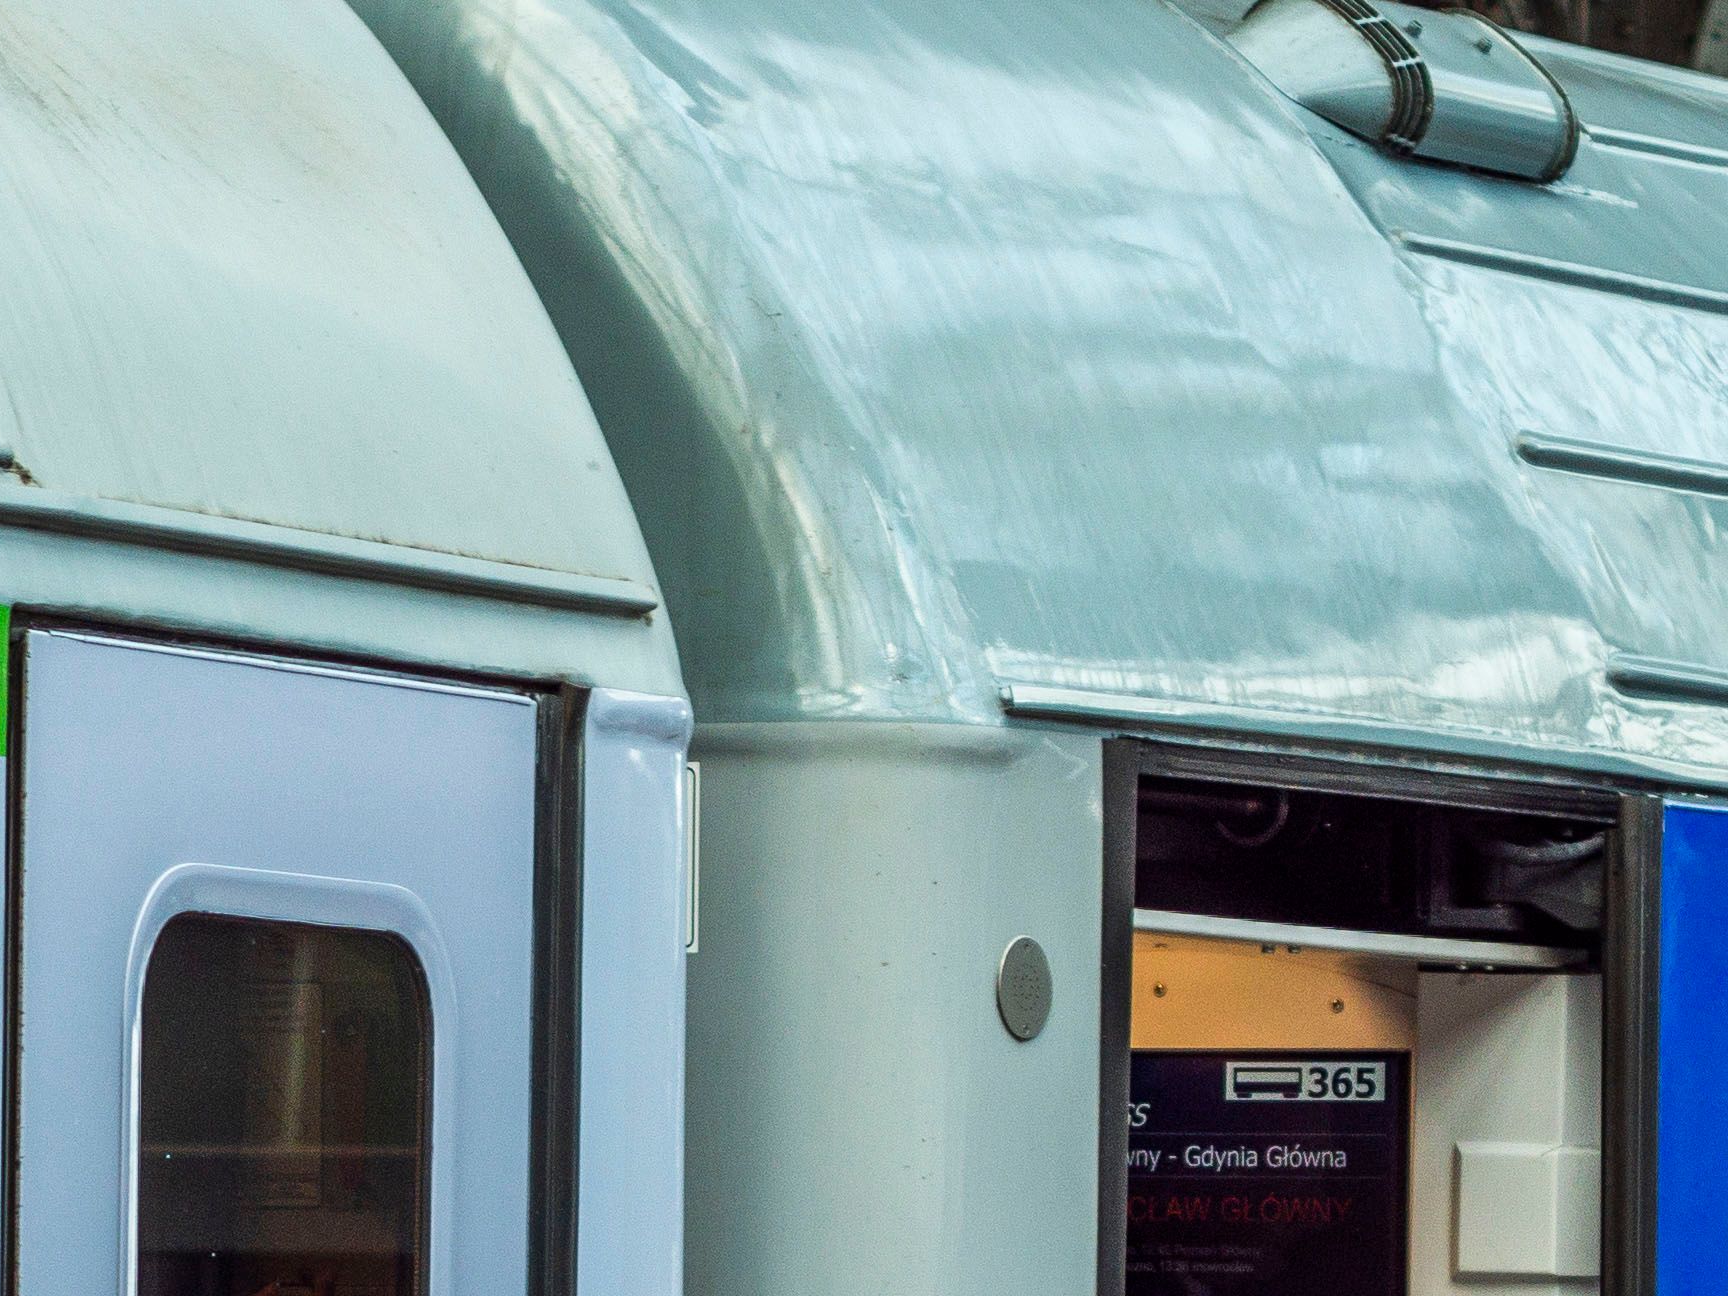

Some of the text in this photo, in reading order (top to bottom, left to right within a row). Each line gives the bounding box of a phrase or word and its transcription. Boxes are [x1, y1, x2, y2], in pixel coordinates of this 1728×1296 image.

[1307, 1067, 1377, 1098] 365
[1184, 1145, 1258, 1171] Gdynia
[1266, 1144, 1347, 1168] Główna
